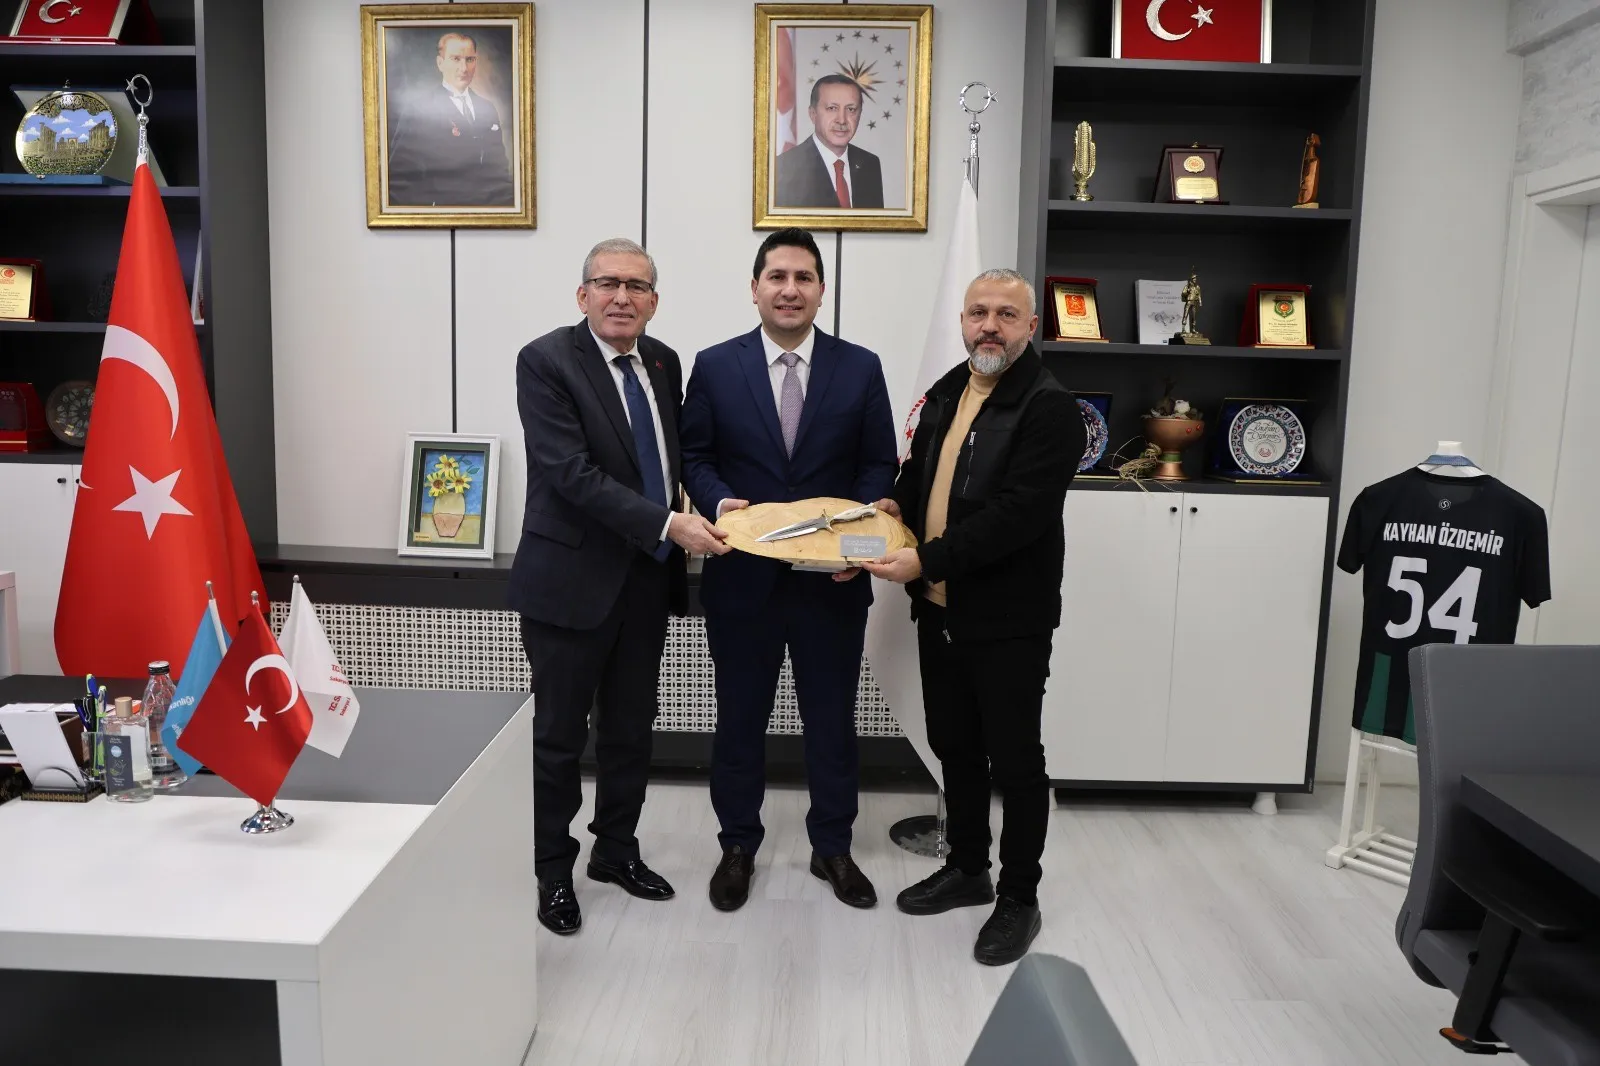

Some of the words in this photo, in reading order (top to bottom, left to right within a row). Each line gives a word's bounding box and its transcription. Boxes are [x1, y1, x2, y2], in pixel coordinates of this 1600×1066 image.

[1383, 522, 1437, 545] KAYHAN
[1438, 521, 1504, 556] ÖZDEMİR
[1384, 555, 1482, 644] 54
